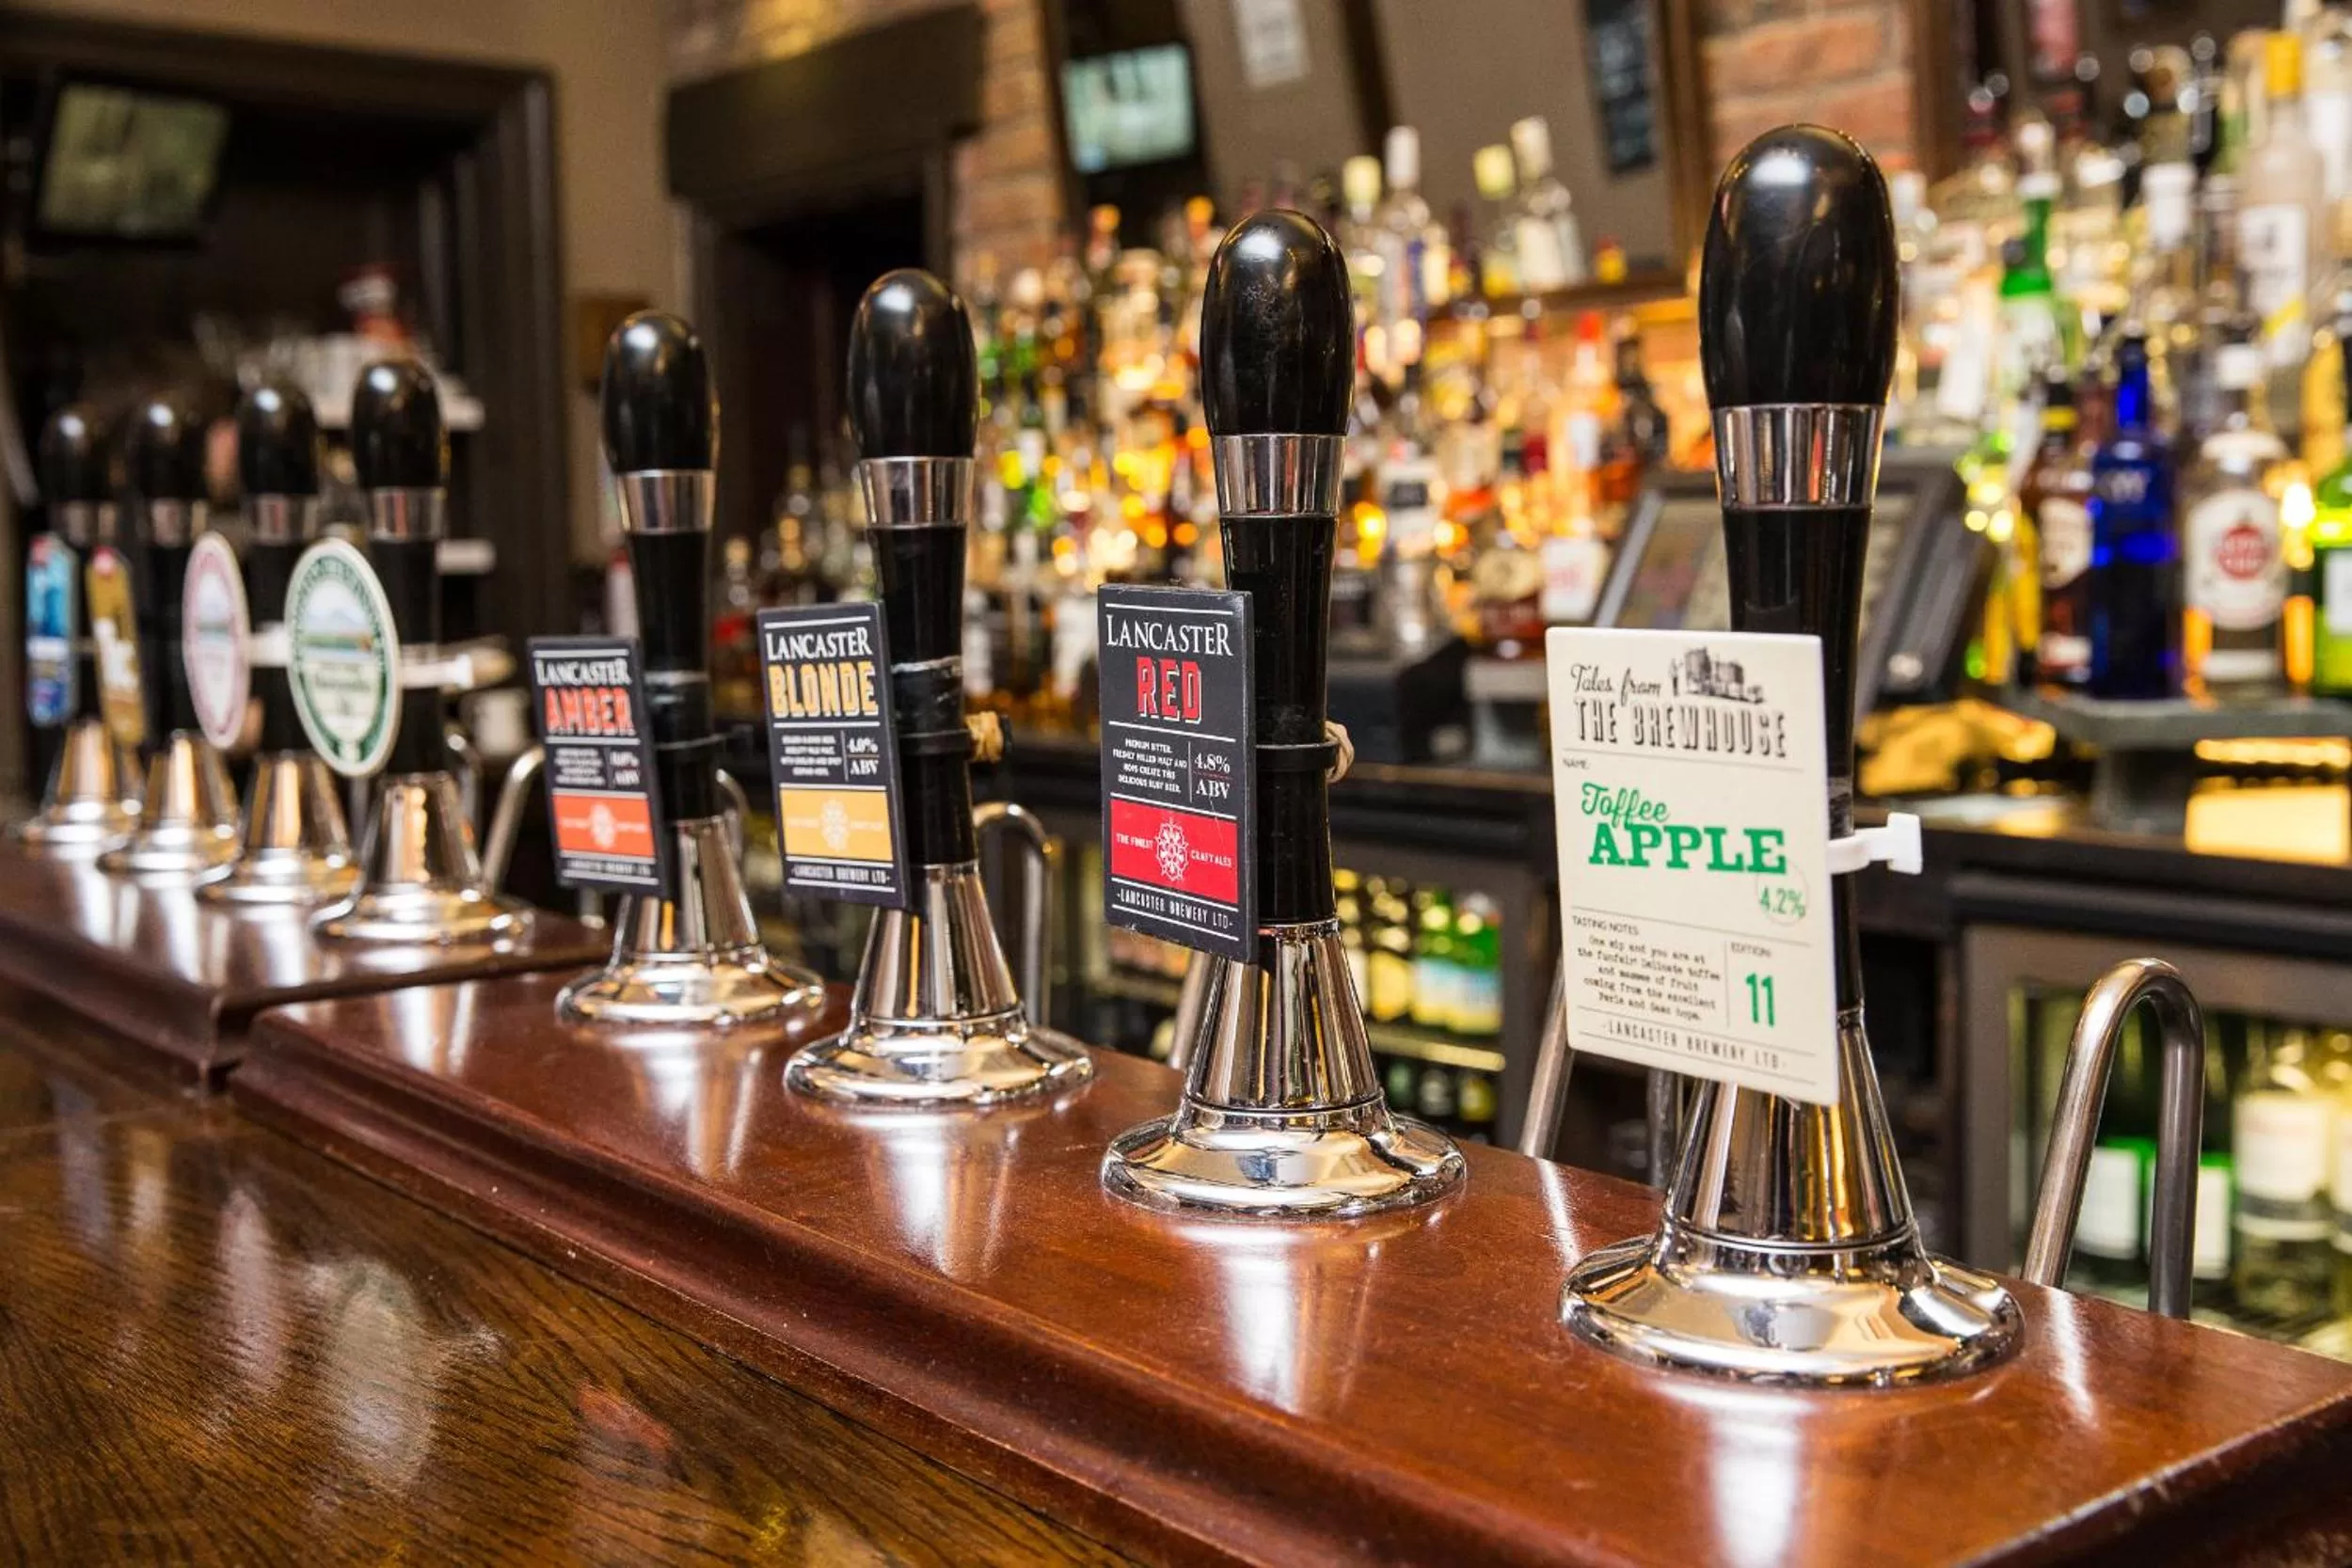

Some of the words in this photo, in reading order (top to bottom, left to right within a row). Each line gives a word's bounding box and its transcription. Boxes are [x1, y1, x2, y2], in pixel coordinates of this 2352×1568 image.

[765, 626, 874, 661] LANCASTER
[1105, 613, 1234, 657] LANCASTER
[534, 657, 633, 687] LANCASTER
[768, 659, 880, 719] BLONDE
[1136, 655, 1202, 725] RED
[1570, 662, 1614, 694] Tales
[1620, 668, 1662, 705] from
[544, 686, 637, 736] AMBER
[1573, 698, 1618, 743] THE
[1632, 704, 1788, 758] BREWHOUSE
[850, 759, 879, 776] ABV
[1195, 752, 1231, 773] 4.8%
[1196, 779, 1231, 799] ABV
[1581, 782, 1671, 829] Toffee
[1588, 821, 1787, 875] APPLE
[1169, 900, 1208, 924] BREWERY
[1759, 885, 1806, 919] 4.2%
[1745, 972, 1776, 1028] 11
[1687, 1036, 1745, 1063] BREWERY
